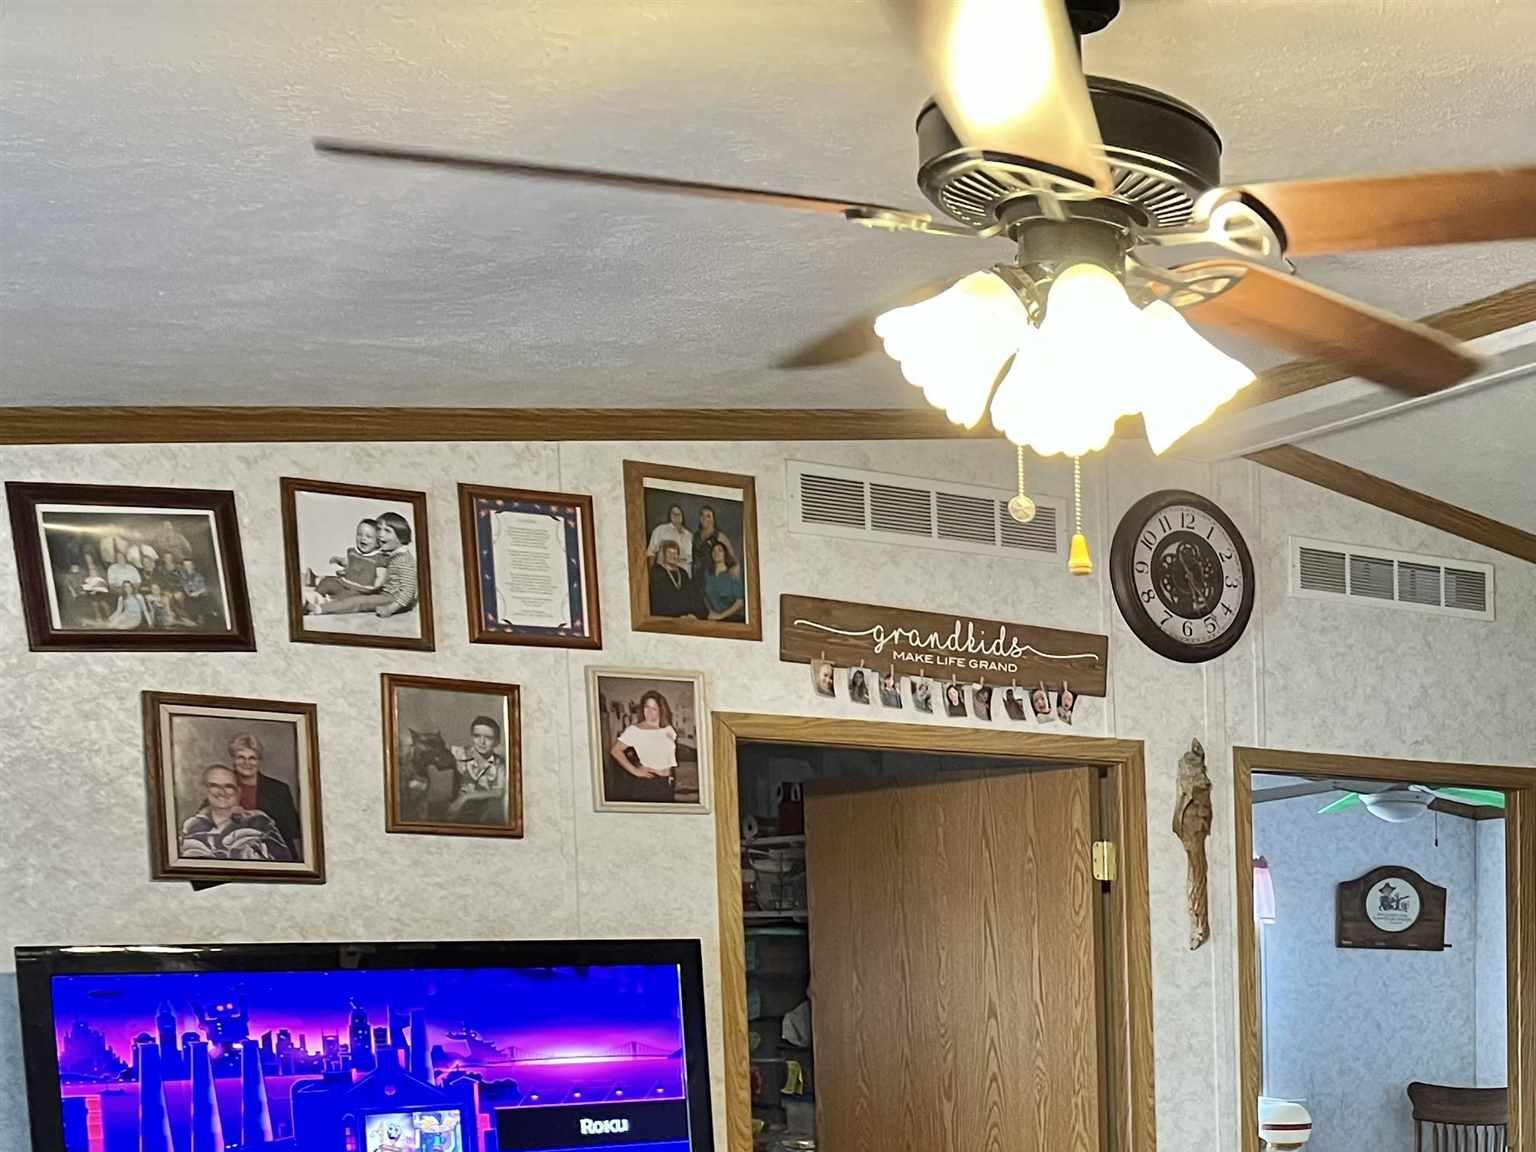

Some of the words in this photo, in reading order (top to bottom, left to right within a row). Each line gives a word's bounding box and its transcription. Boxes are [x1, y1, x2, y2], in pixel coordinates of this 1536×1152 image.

[1157, 515, 1172, 533] 11
[1181, 511, 1196, 530] 12
[1140, 530, 1158, 551] 10
[1206, 526, 1215, 540] 1
[1219, 548, 1233, 563] 2
[1135, 560, 1149, 575] 9
[1224, 575, 1239, 589] 3
[1141, 588, 1156, 604] 8
[1221, 601, 1233, 616] 4
[1160, 609, 1174, 626] 7
[1203, 616, 1217, 634] 5
[1181, 620, 1193, 637] 6
[873, 619, 1023, 658] grandkids
[893, 651, 934, 664] MAKE
[936, 655, 966, 668] LIFE
[968, 658, 1018, 673] GRAND
